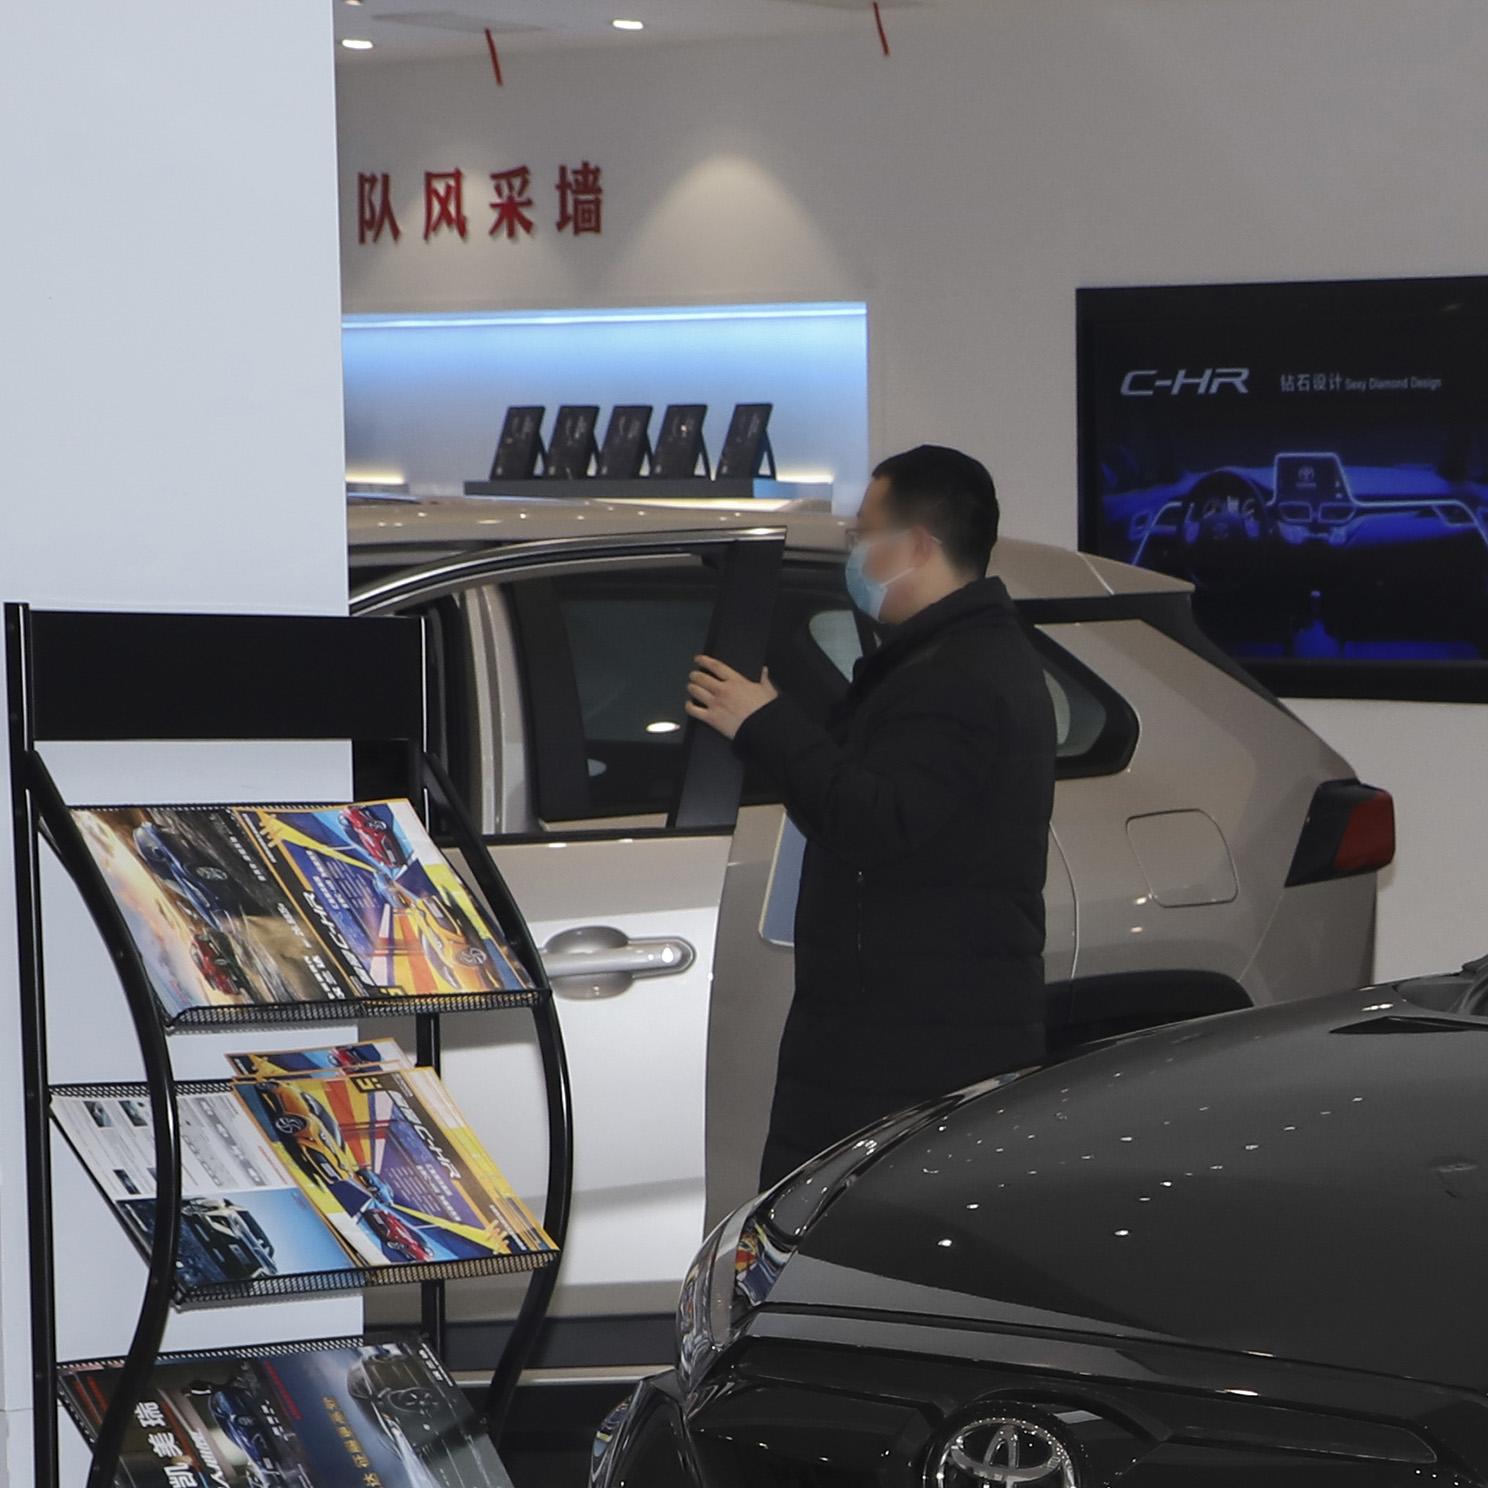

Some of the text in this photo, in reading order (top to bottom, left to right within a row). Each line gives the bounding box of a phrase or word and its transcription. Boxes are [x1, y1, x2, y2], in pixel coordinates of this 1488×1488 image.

[357, 161, 603, 244] 队风采墙
[1120, 367, 1249, 396] C-HR
[1280, 373, 1343, 393] 钻石设计
[1369, 376, 1408, 391] Diamond
[1410, 375, 1442, 390] Design
